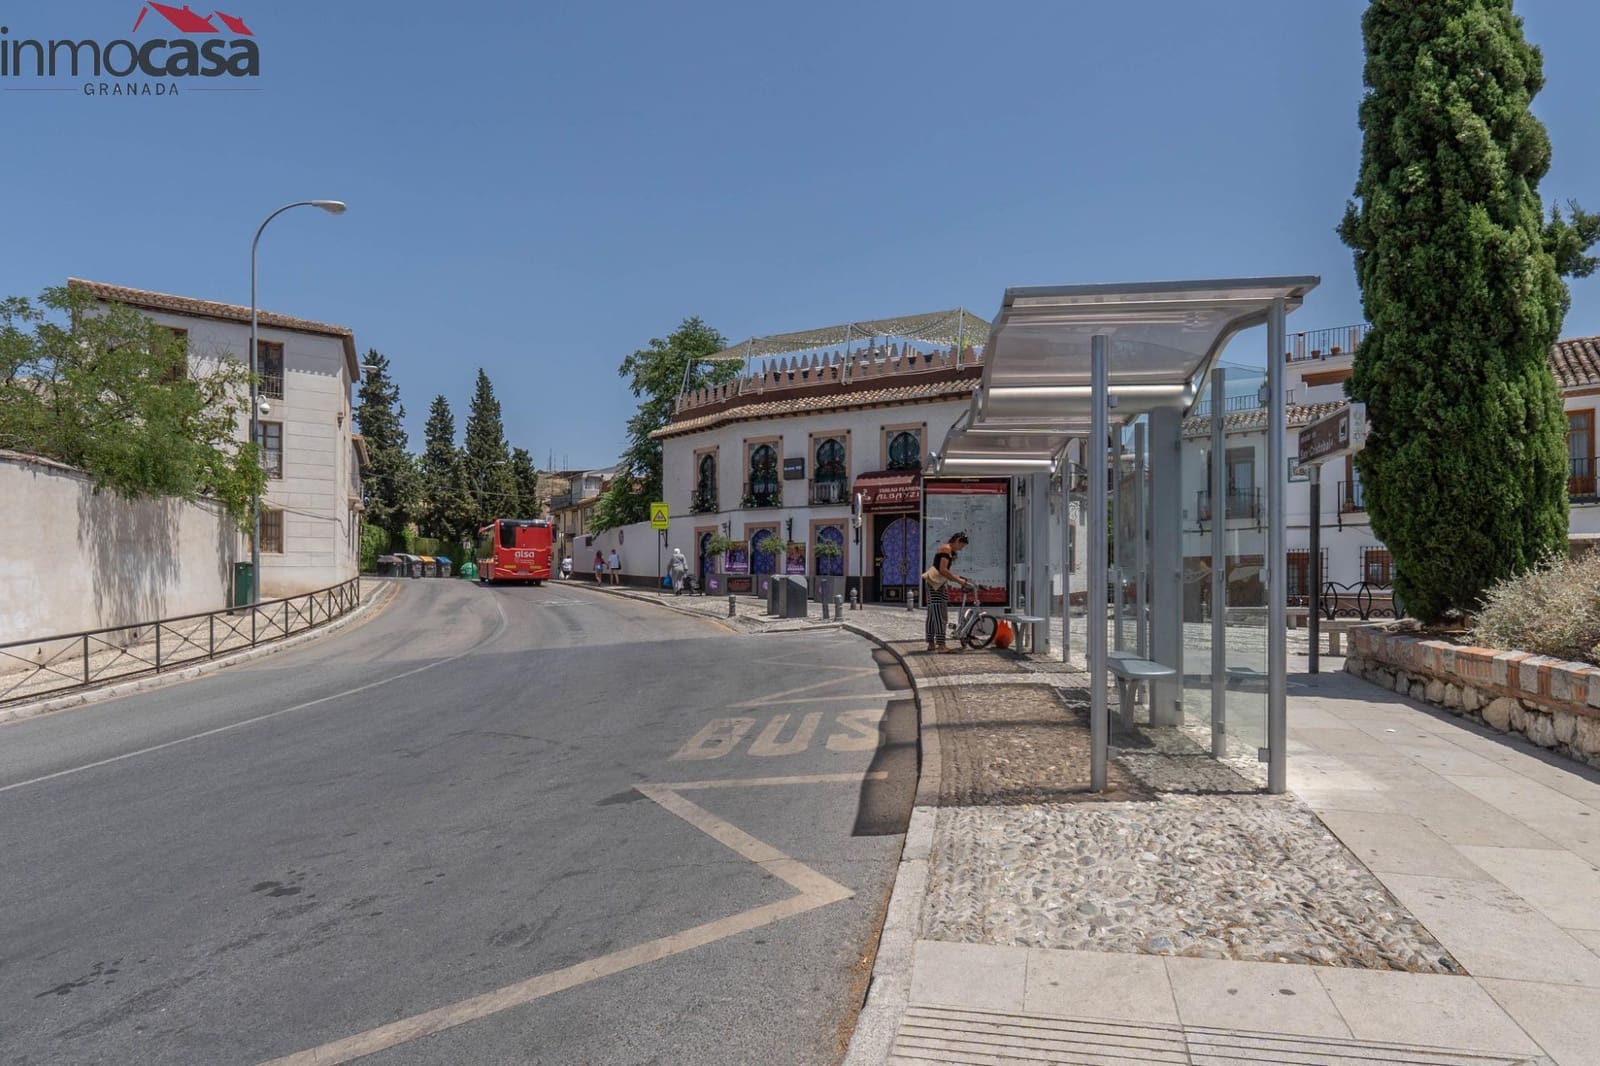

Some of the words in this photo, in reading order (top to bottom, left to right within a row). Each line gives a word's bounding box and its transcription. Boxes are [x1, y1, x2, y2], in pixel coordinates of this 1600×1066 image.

[876, 491, 920, 500] ALBAYZI
[514, 550, 534, 558] alsa
[667, 708, 887, 762] BUS
